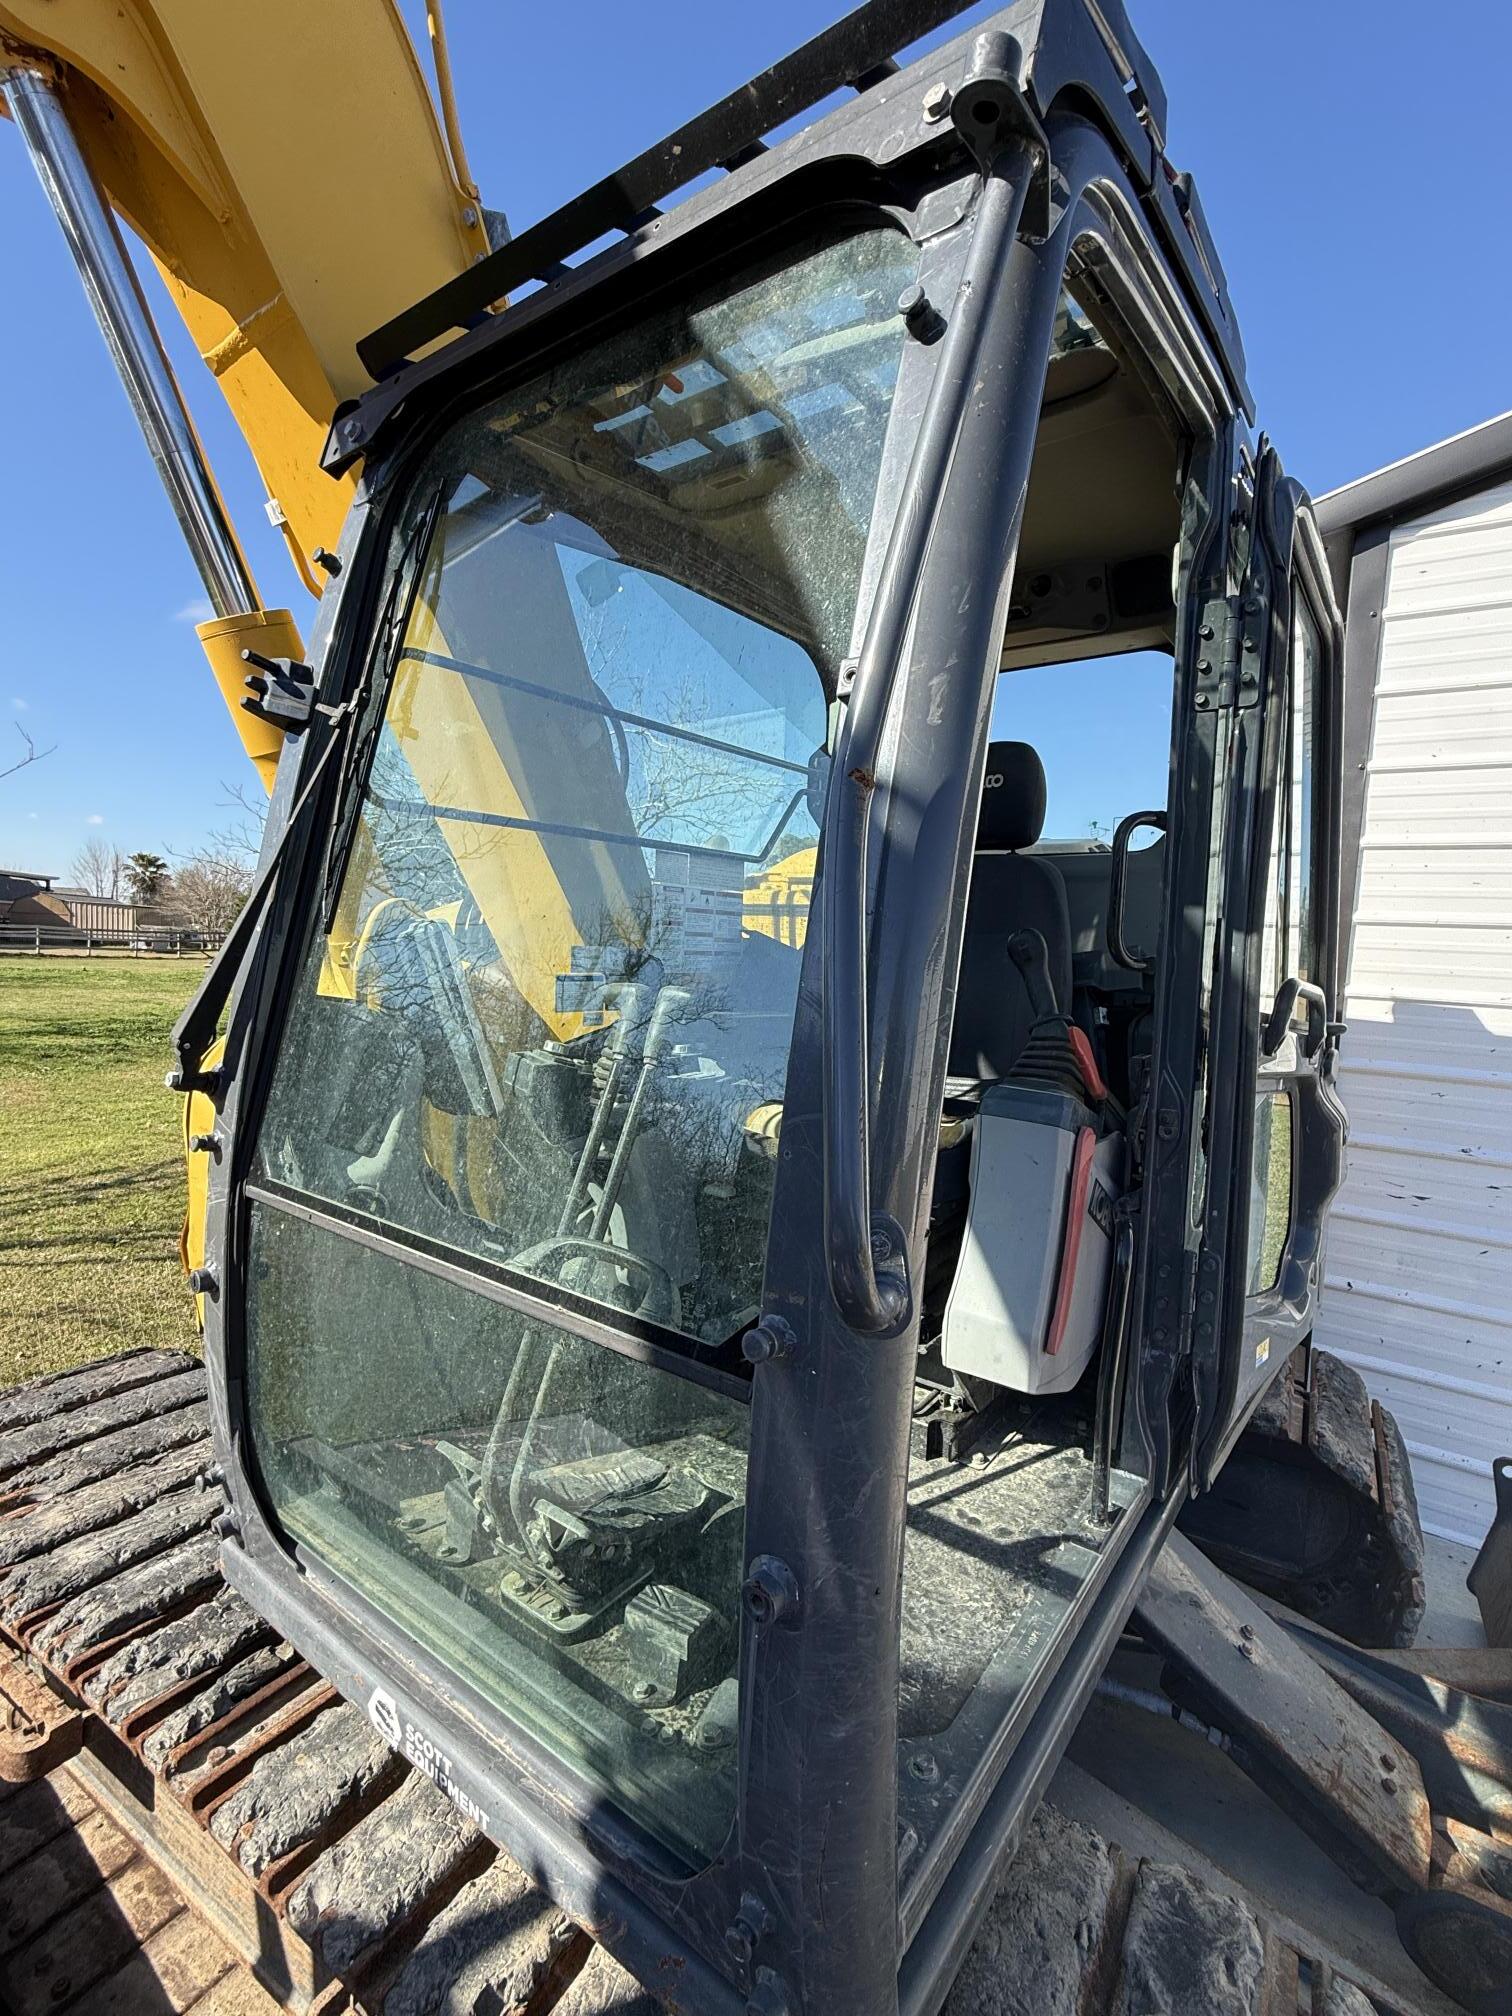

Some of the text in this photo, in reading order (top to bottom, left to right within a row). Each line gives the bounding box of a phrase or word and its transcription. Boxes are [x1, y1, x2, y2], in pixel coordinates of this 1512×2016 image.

[983, 774, 1004, 788] CO
[406, 1723, 453, 1776] SCOTT
[405, 1741, 490, 1831] EQUIPMENT
